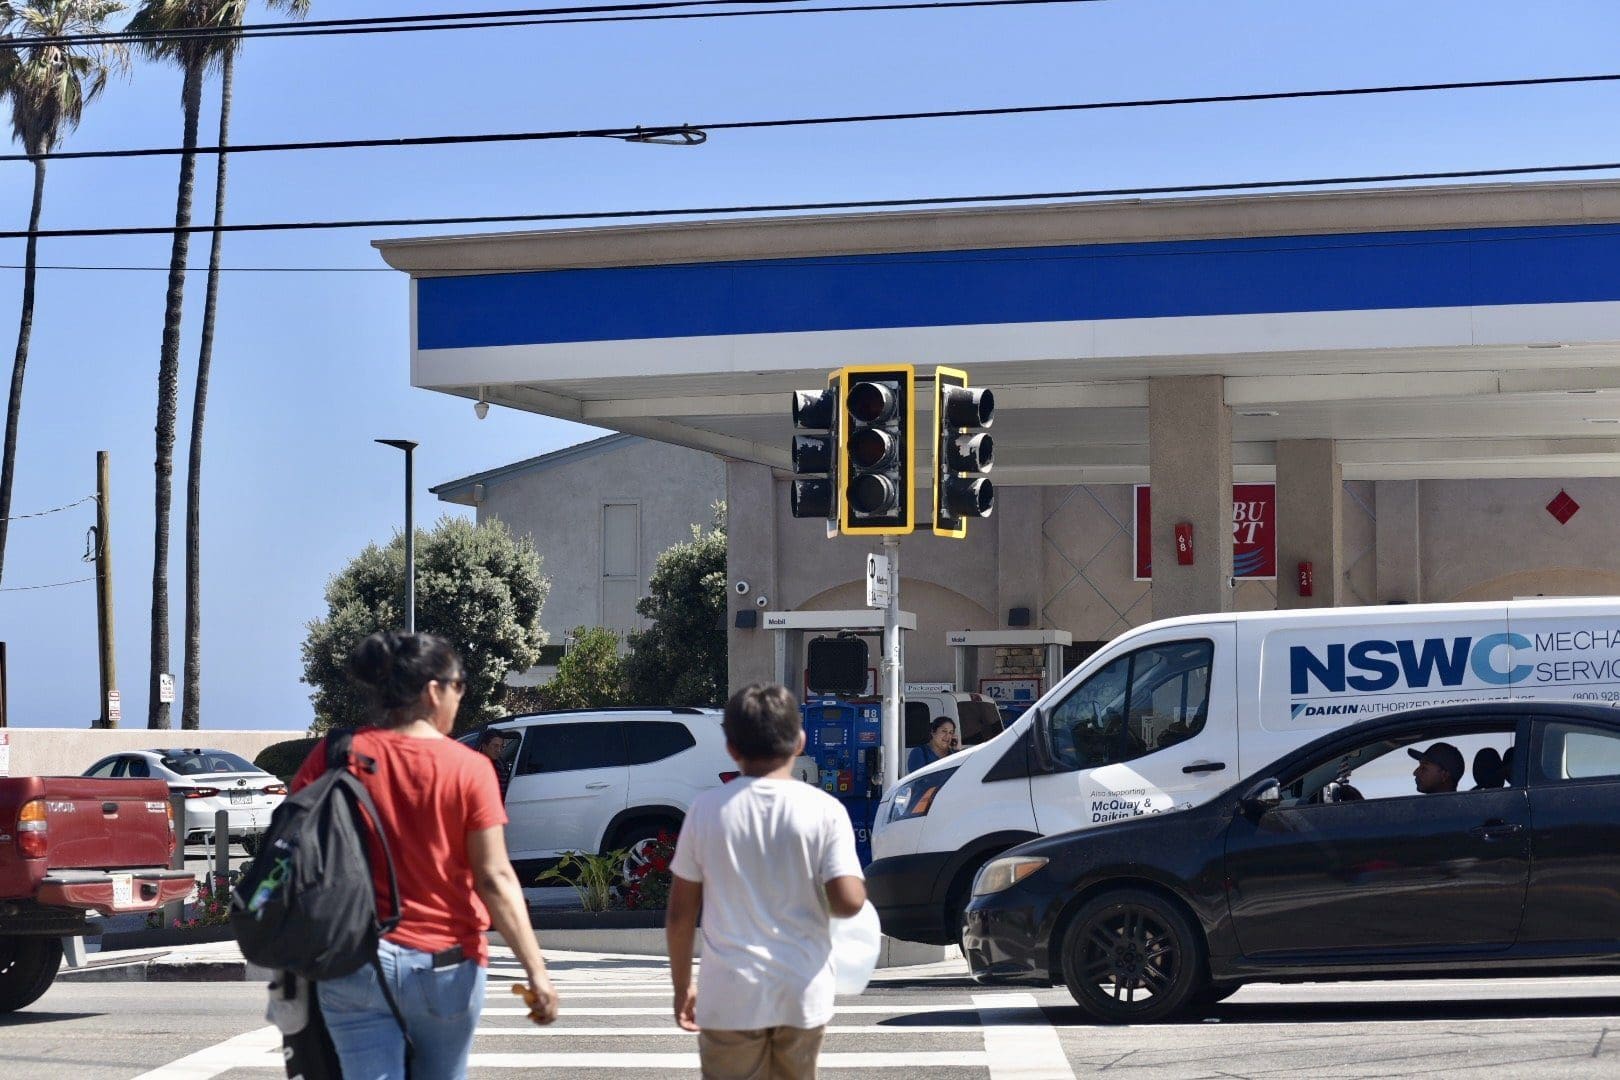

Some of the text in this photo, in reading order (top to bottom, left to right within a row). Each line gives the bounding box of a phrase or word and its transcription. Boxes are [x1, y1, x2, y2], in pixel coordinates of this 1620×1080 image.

[1290, 632, 1535, 695] NSWC
[1305, 704, 1358, 717] DAIKIN
[1107, 788, 1146, 798] supporting
[1091, 797, 1152, 812] McQuay &
